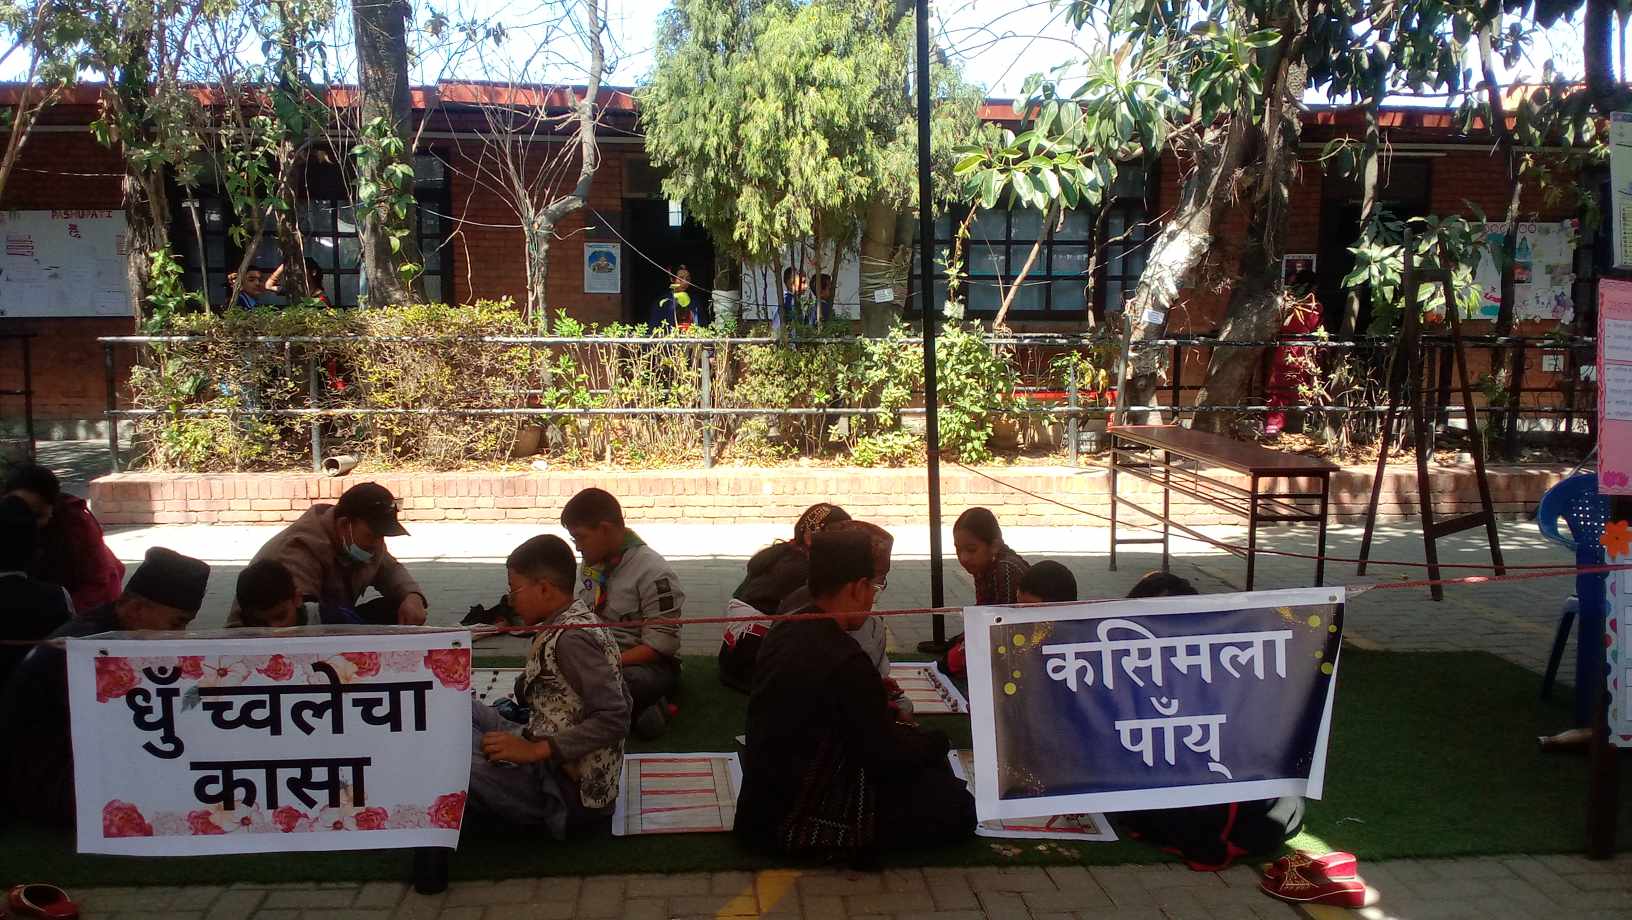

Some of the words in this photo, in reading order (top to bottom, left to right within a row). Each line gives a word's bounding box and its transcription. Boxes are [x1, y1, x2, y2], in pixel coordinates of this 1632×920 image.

[1042, 619, 1294, 692] कसिमला
[197, 661, 434, 736] च्वलेचा
[1114, 697, 1233, 779] पाँय्
[190, 757, 371, 810] कासा
